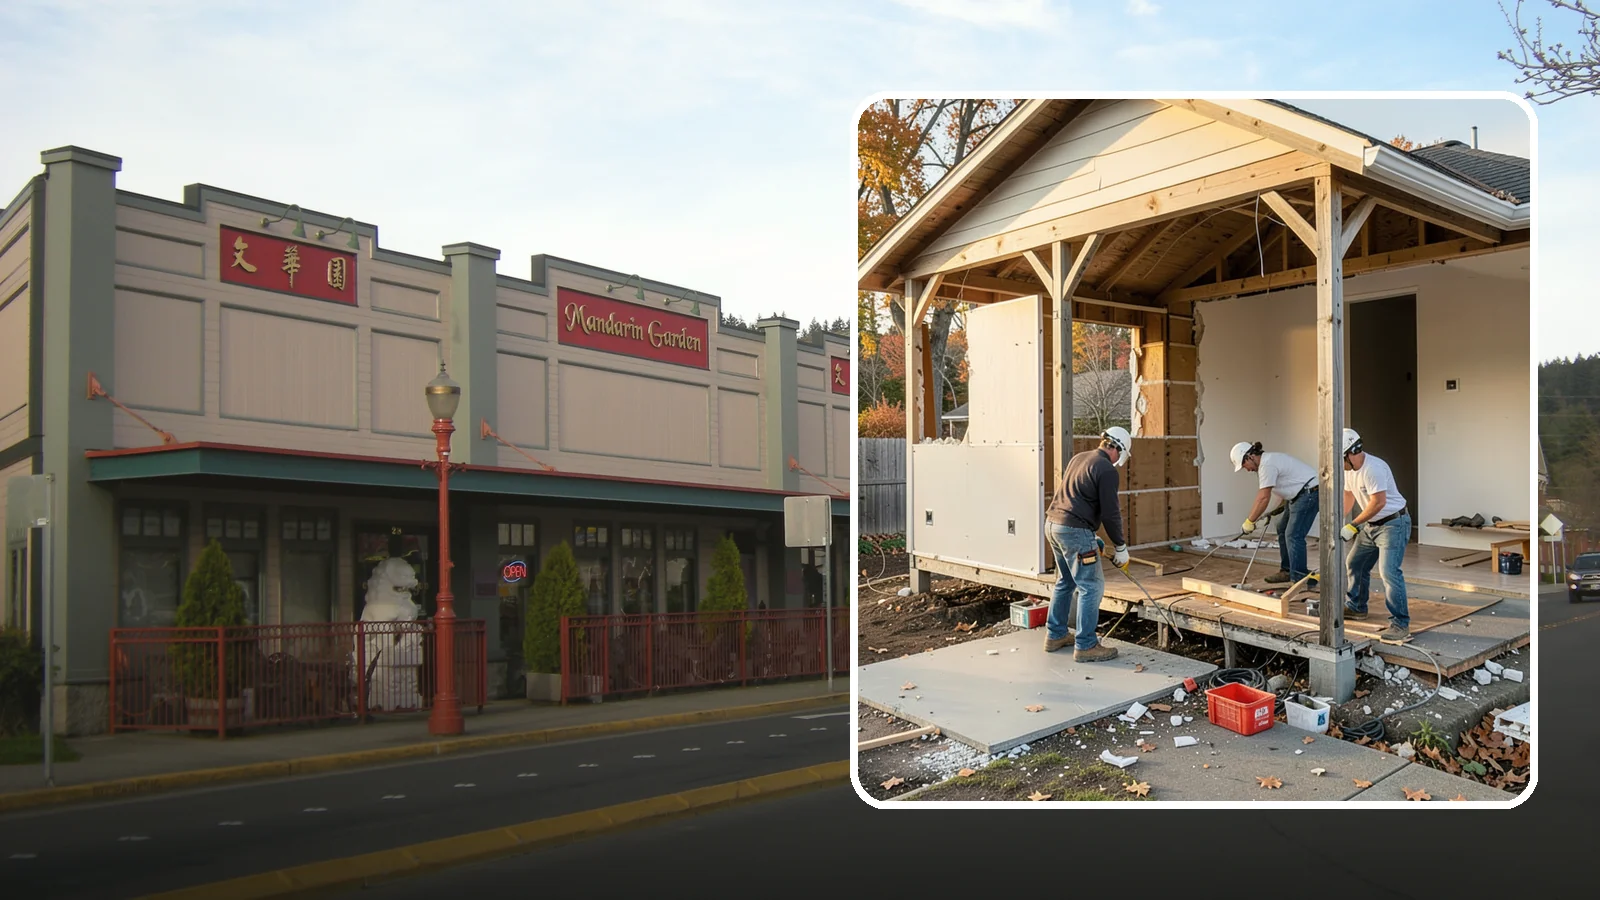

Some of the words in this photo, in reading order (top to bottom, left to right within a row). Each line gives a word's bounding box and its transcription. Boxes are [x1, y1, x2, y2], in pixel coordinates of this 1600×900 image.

[564, 302, 644, 341] Mandarin
[648, 321, 701, 351] Garden
[503, 565, 526, 578] OPEN
